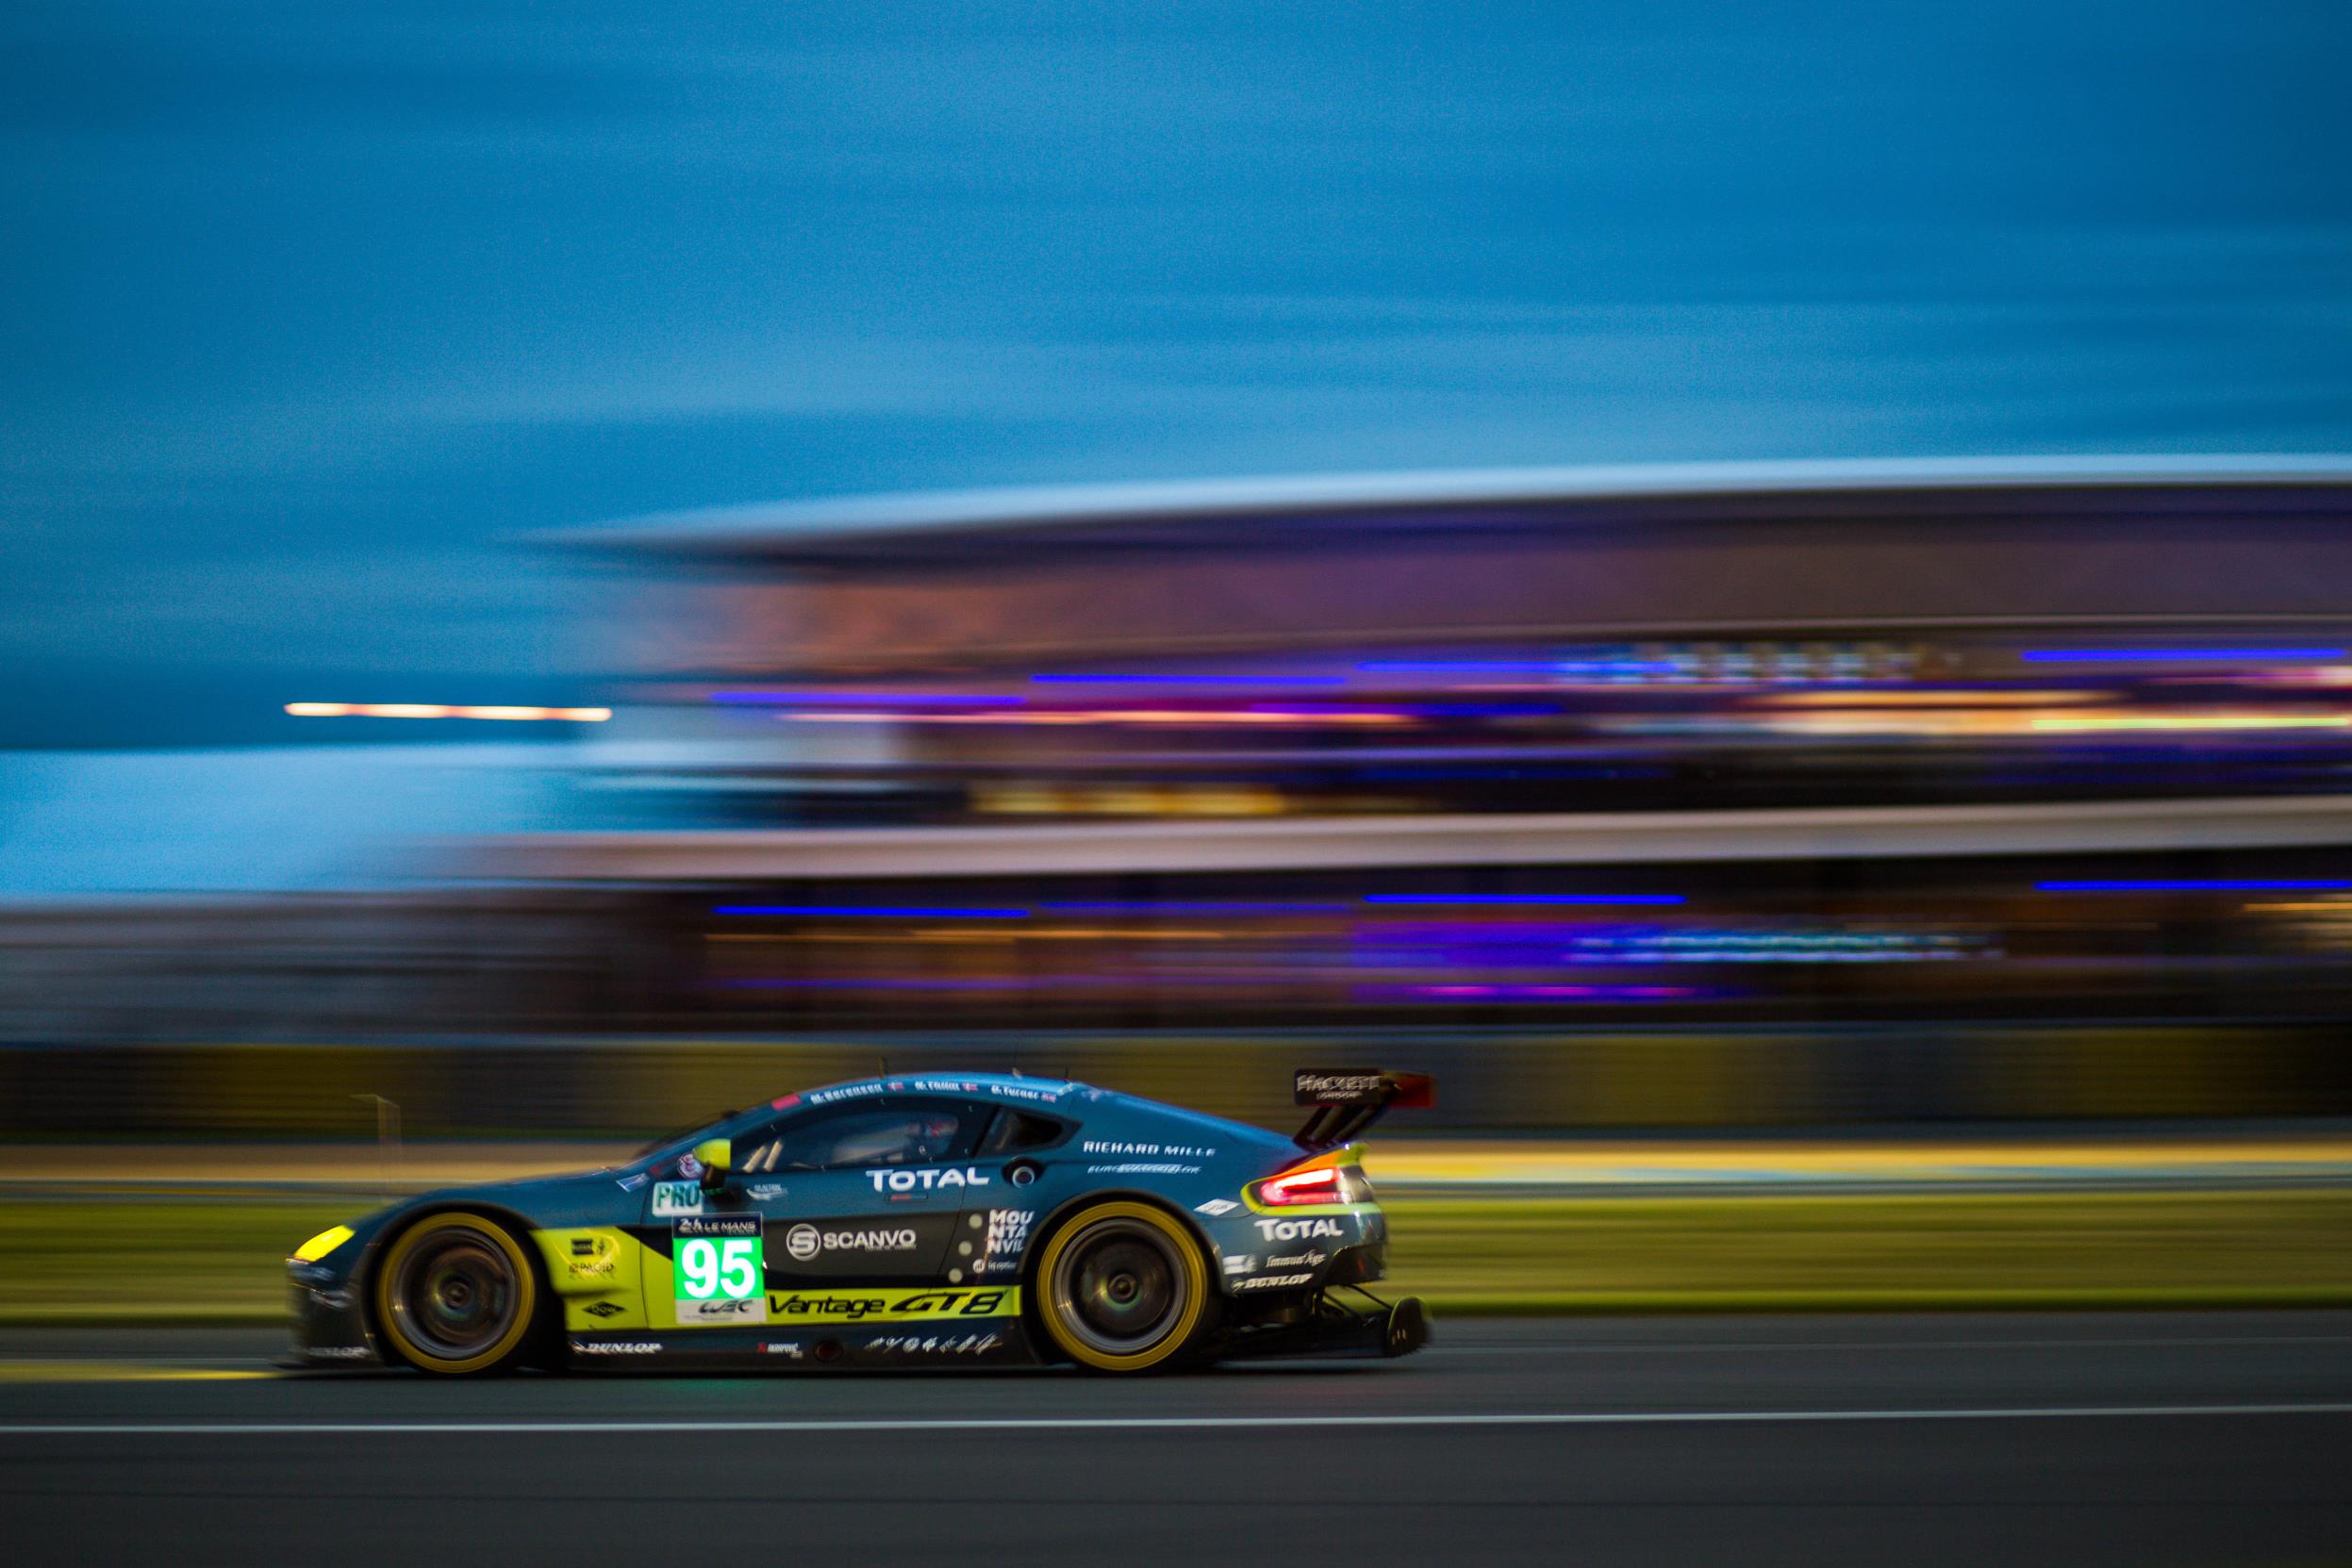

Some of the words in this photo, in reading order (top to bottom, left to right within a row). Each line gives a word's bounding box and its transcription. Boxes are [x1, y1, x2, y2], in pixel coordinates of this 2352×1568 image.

[1084, 1141, 1159, 1154] RICHARD
[1165, 1146, 1217, 1157] MILLE
[866, 1167, 989, 1192] TOTAL
[656, 1181, 701, 1208] PRO
[989, 1209, 1035, 1225] MOU
[704, 1222, 719, 1232] LE
[721, 1221, 756, 1232] MANS
[987, 1224, 1028, 1239] NTA
[1253, 1218, 1344, 1242] TOTAL
[823, 1230, 917, 1249] SCANVO
[682, 1239, 755, 1298] 95
[1244, 1273, 1314, 1289] DUNLOP
[769, 1295, 885, 1318] Vantage
[889, 1291, 1006, 1314] GT8
[588, 1343, 663, 1354] DUNLOP
